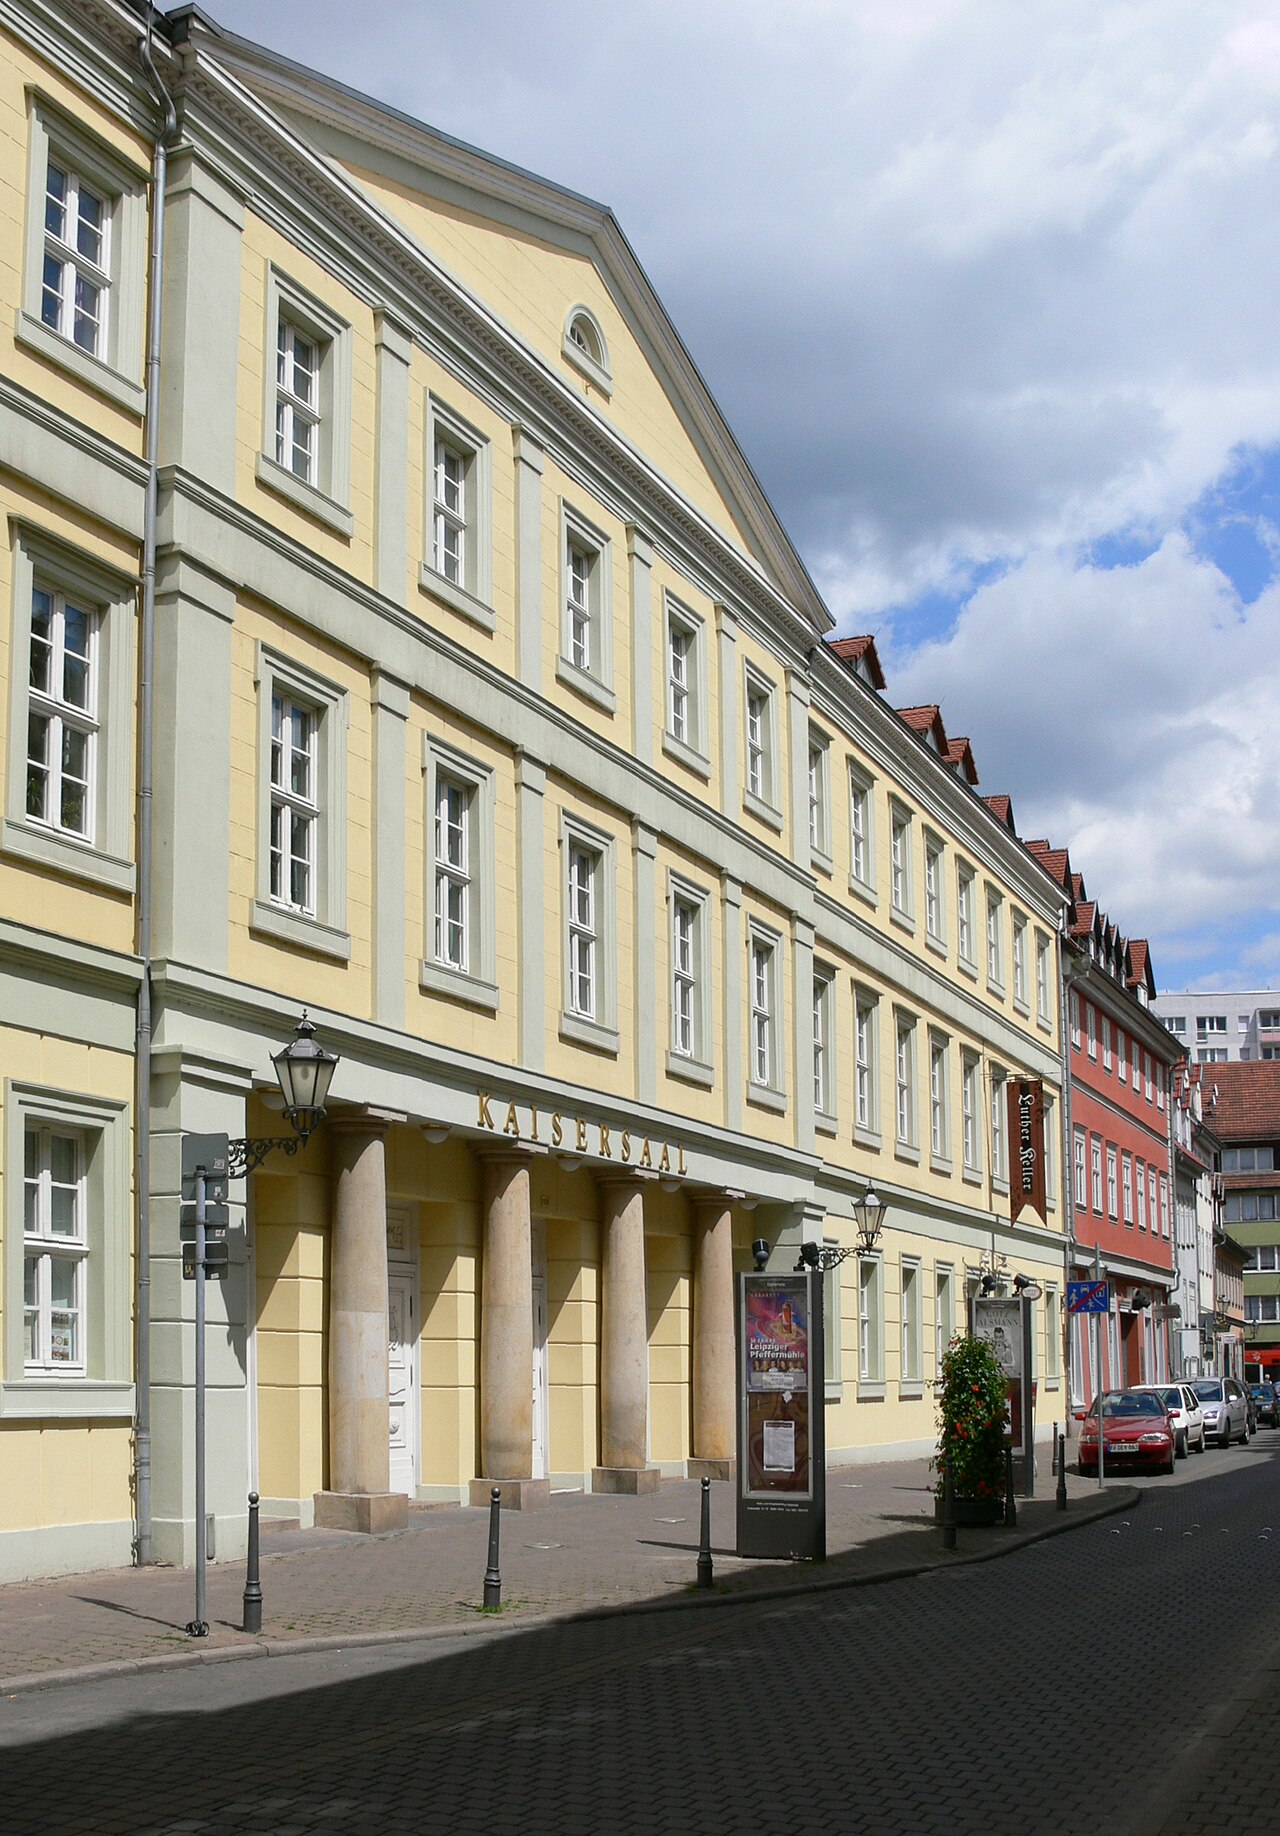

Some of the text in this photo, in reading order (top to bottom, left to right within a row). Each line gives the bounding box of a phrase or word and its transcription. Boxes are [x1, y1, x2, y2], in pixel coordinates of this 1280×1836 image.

[477, 1090, 688, 1175] KAISERSAAL
[1018, 1094, 1037, 1190] Luther Keller
[750, 1343, 789, 1352] Leipziger
[750, 1350, 805, 1358] Pfeffermühle
